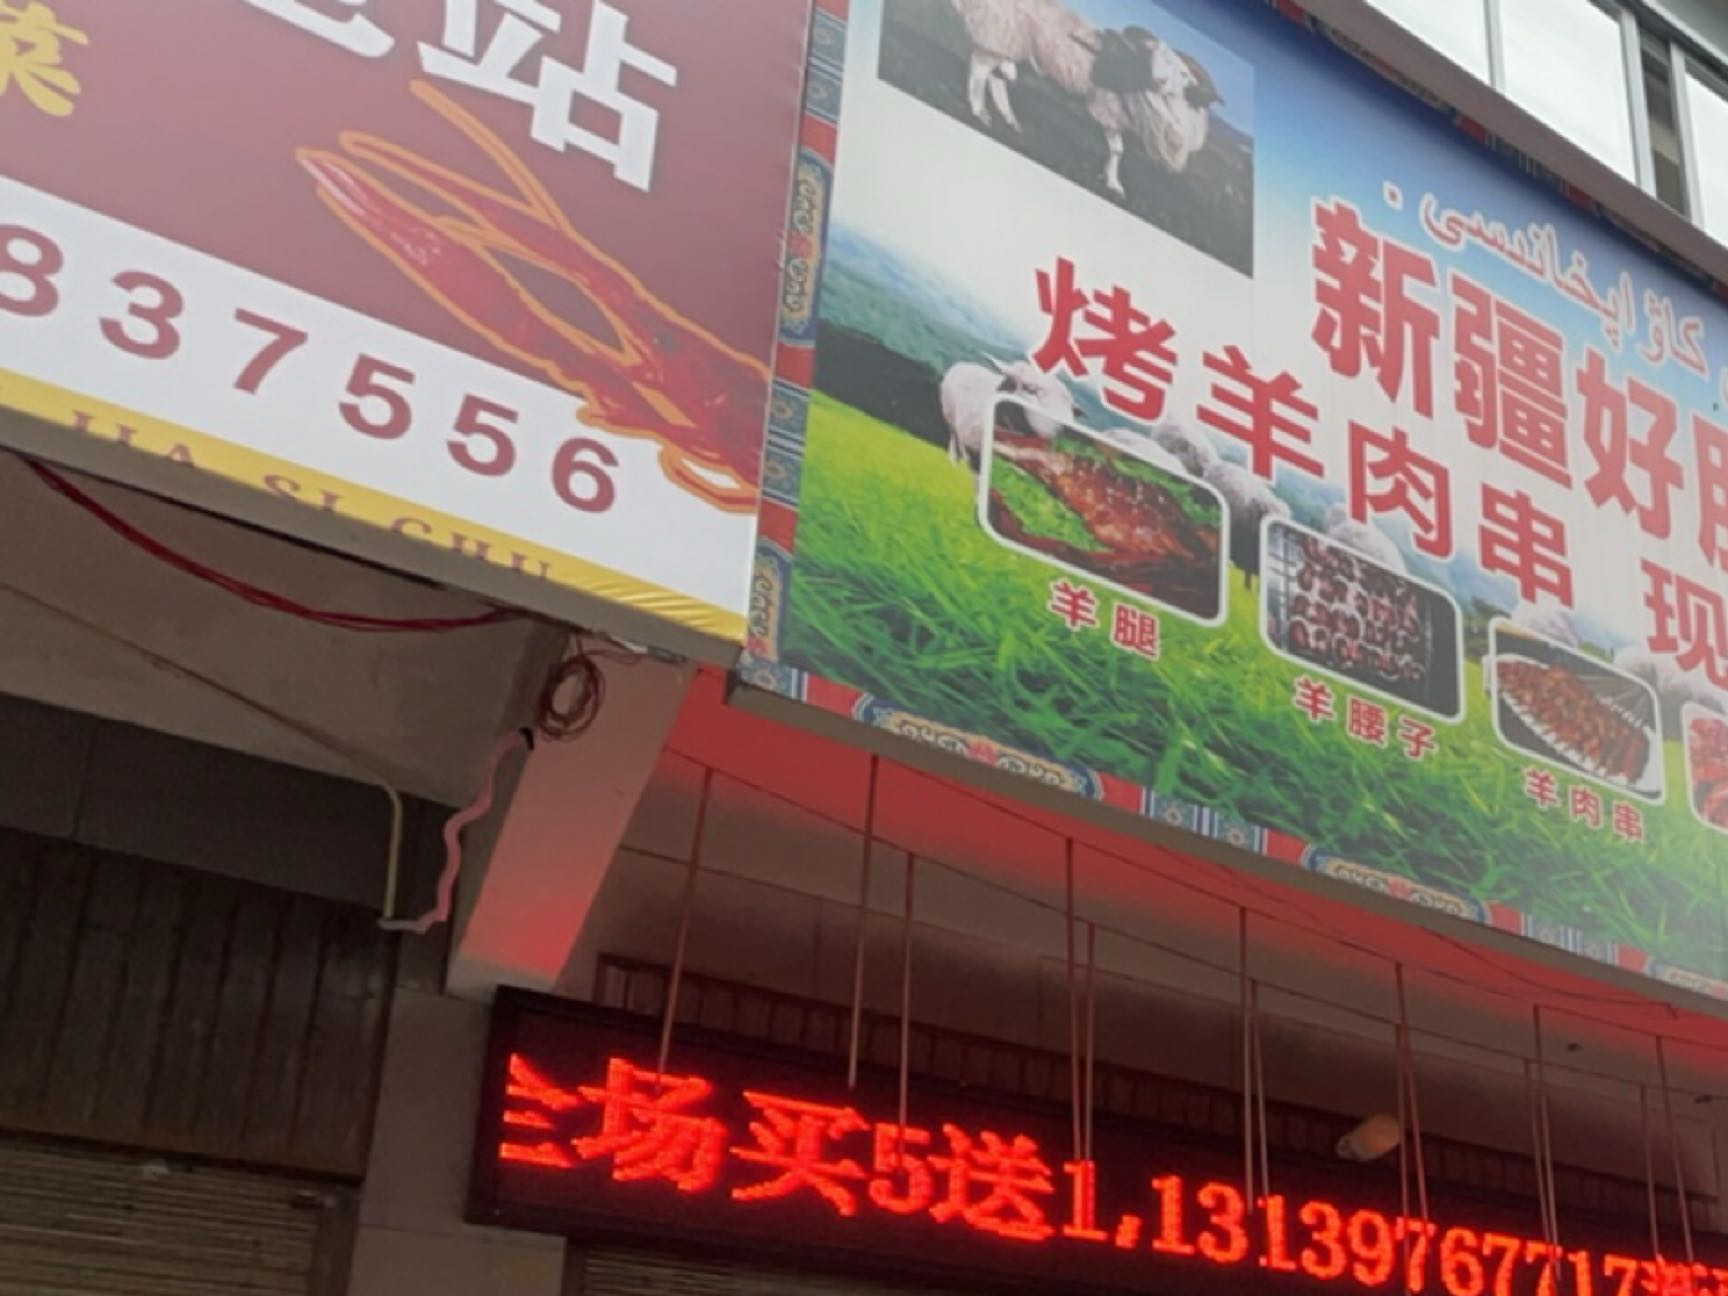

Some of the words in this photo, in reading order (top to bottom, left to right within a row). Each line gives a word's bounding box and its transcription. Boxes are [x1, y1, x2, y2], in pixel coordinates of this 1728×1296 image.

[0, 224, 620, 514] 837556
[1031, 257, 1575, 611] 烤羊肉串
[1049, 581, 1163, 660] 羊腿
[1524, 766, 1644, 843] 羊肉串
